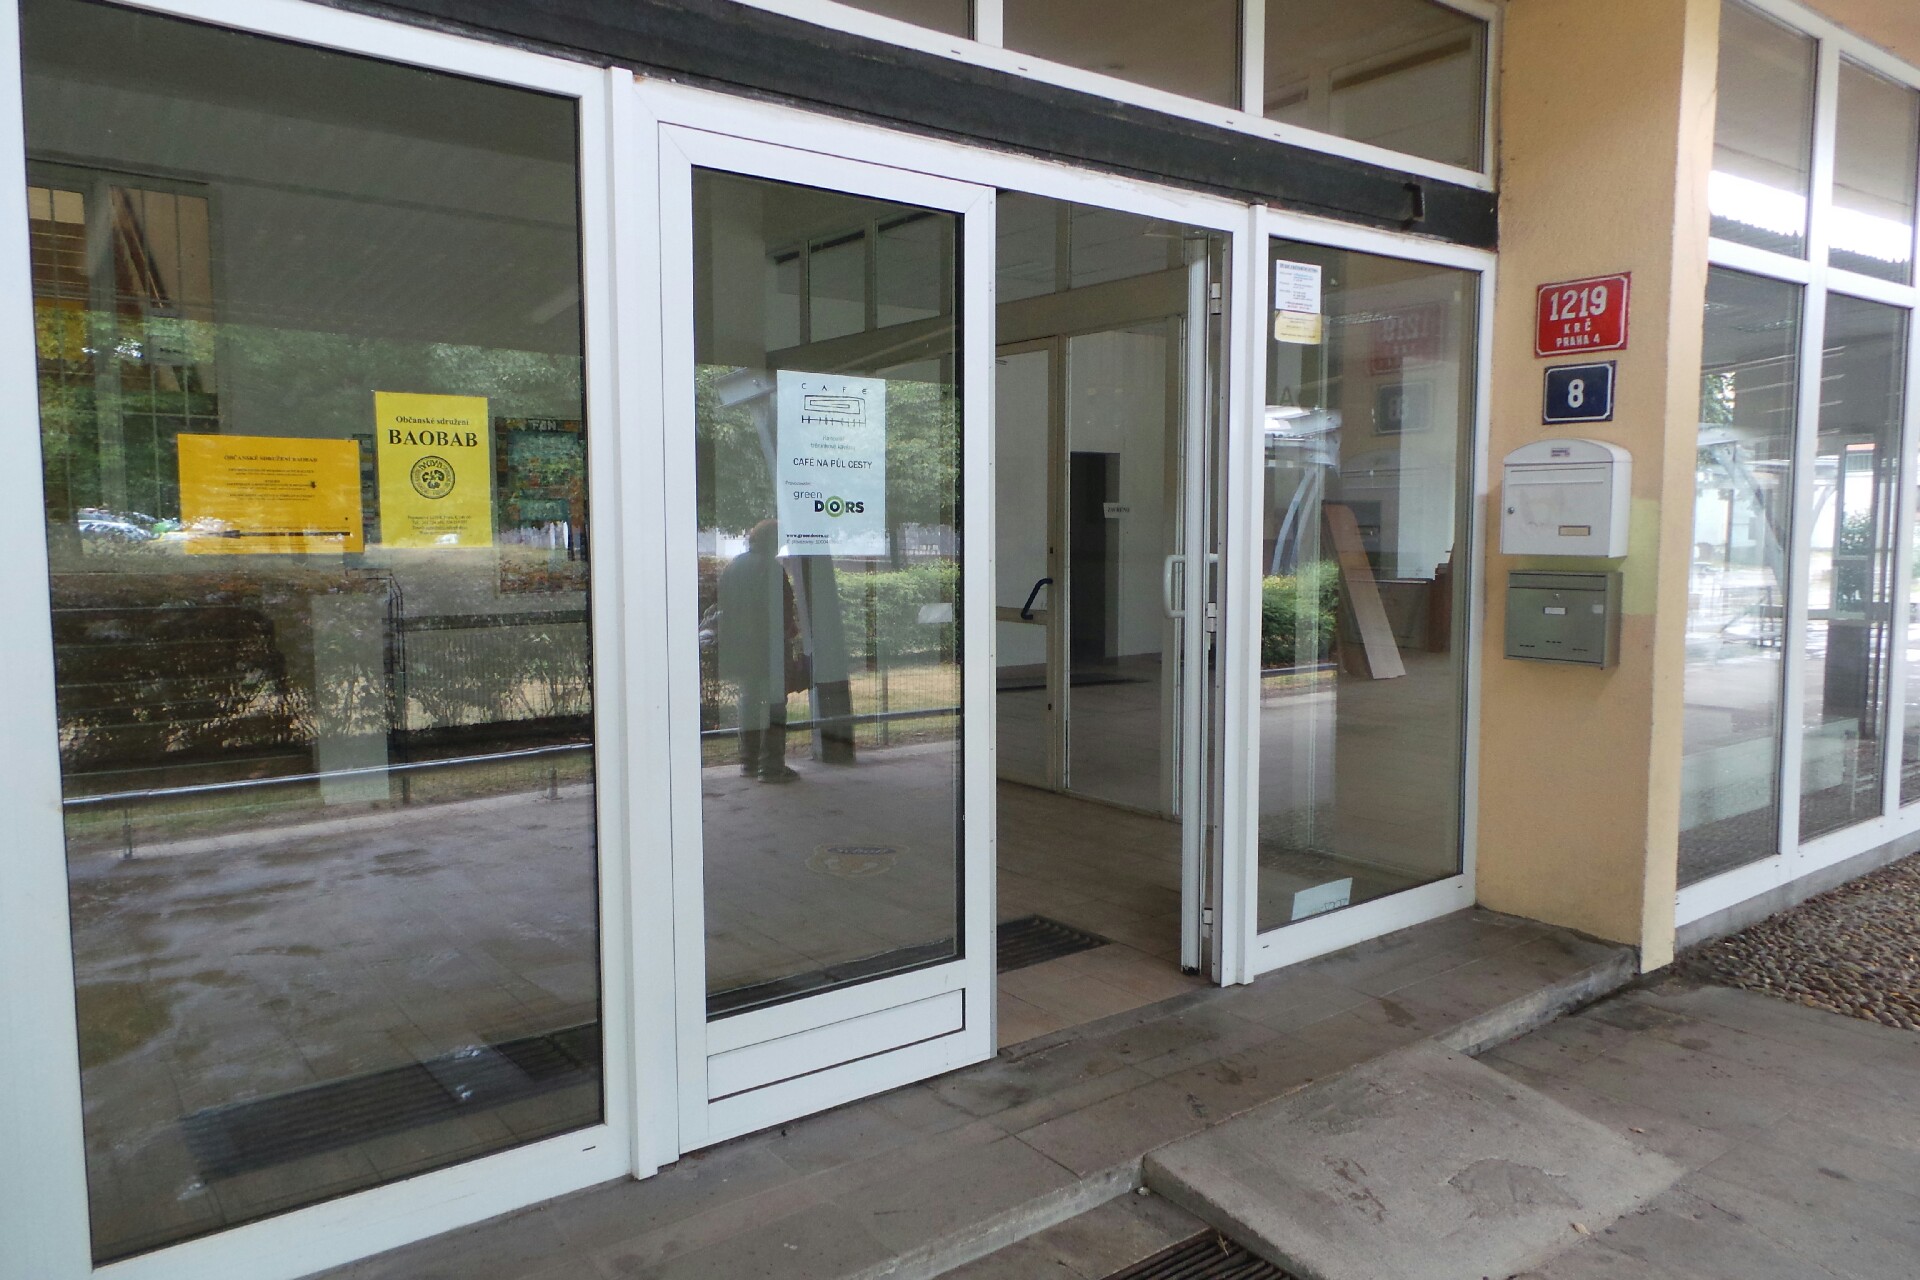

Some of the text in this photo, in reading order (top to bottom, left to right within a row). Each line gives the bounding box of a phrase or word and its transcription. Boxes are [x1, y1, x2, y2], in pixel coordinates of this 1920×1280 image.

[1550, 286, 1607, 321] 1219
[1564, 318, 1591, 334] KRČ
[1556, 333, 1600, 347] PRAHA 4
[1567, 378, 1585, 408] 8
[395, 415, 469, 426] Občanské sdružení
[387, 428, 478, 447] BAOBAB
[816, 459, 828, 468] NA
[847, 460, 873, 470] CESTY
[793, 490, 823, 500] green
